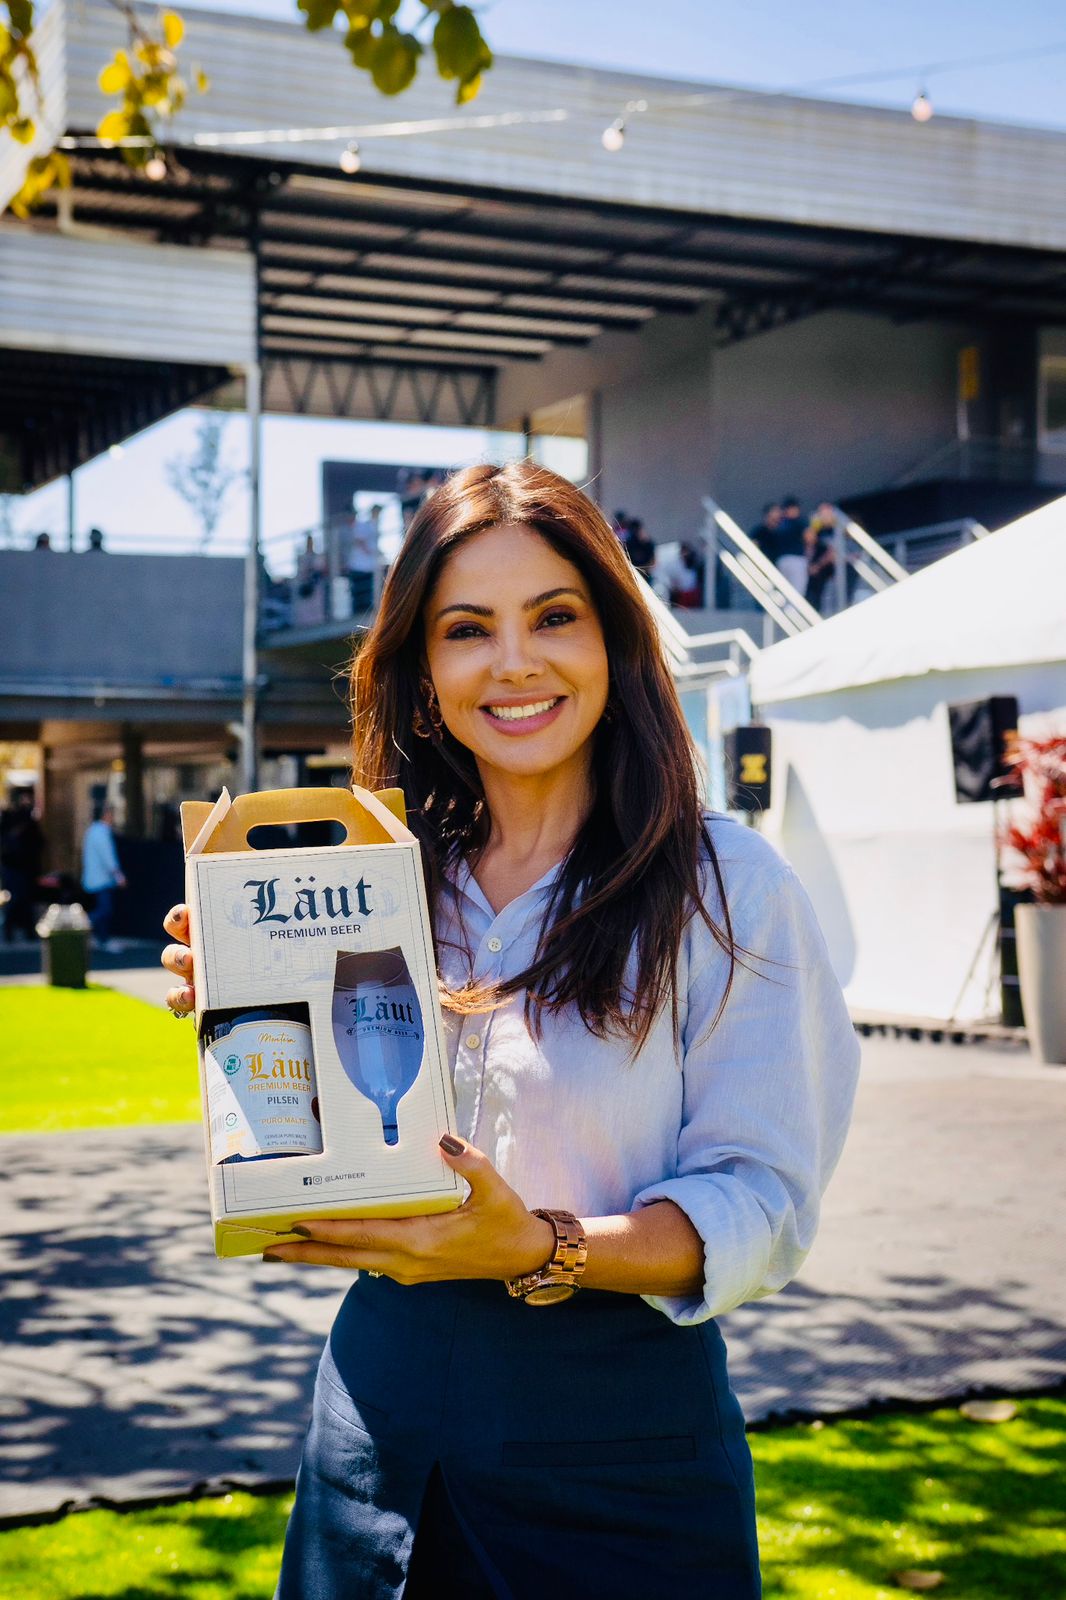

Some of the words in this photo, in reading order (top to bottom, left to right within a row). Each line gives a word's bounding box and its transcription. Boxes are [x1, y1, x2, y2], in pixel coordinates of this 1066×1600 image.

[243, 876, 373, 925] Läut
[270, 927, 327, 940] PREMIUM
[330, 924, 361, 936] BEER
[348, 995, 414, 1025] Läut
[362, 1025, 392, 1033] PREMIUM
[244, 1051, 311, 1082] Läut
[248, 1082, 290, 1092] PREMIUM
[292, 1082, 311, 1092] BEER
[267, 1096, 299, 1105] PILSEN
[261, 1117, 282, 1125] PURO
[285, 1117, 308, 1125] MALTE
[324, 1172, 366, 1183] @LAUTBEER
